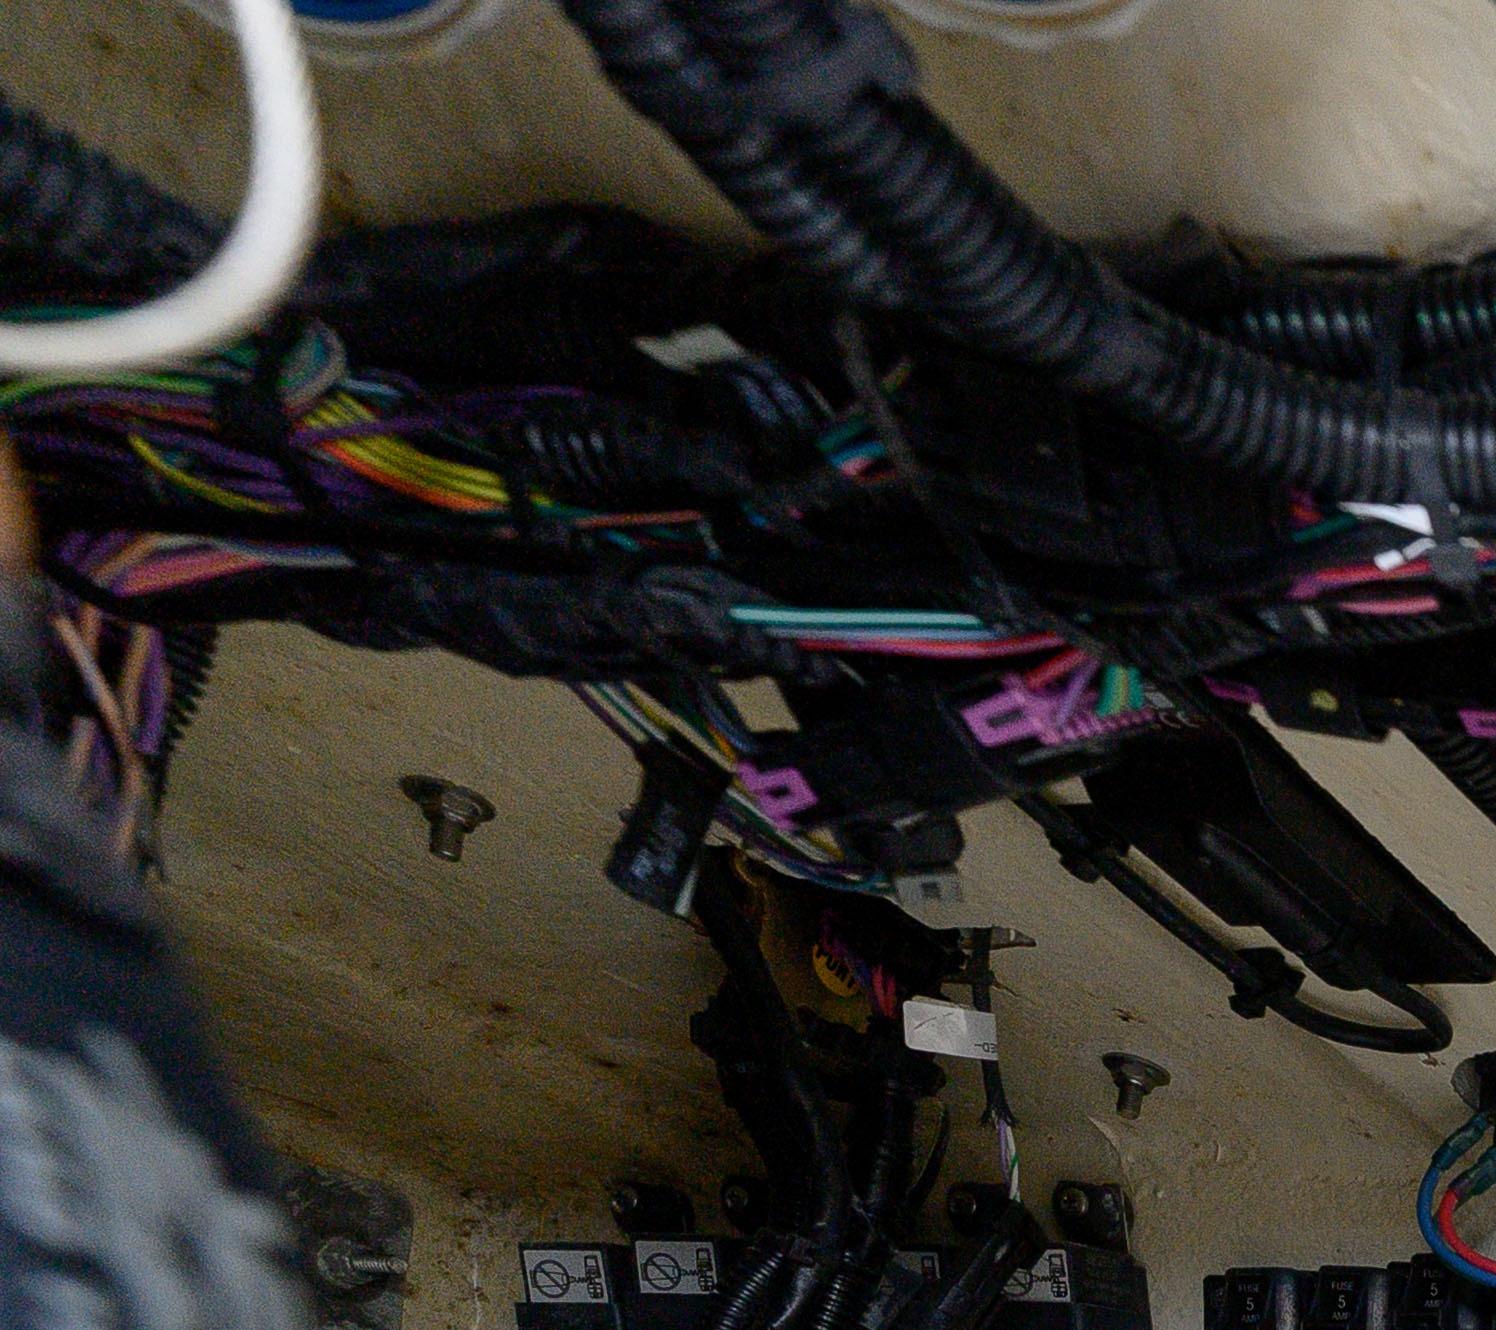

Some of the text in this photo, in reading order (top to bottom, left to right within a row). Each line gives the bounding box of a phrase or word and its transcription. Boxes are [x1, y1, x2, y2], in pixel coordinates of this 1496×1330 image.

[1332, 1281, 1354, 1290] FUSE
[1246, 1297, 1254, 1311] 5
[1337, 1295, 1346, 1308] 5
